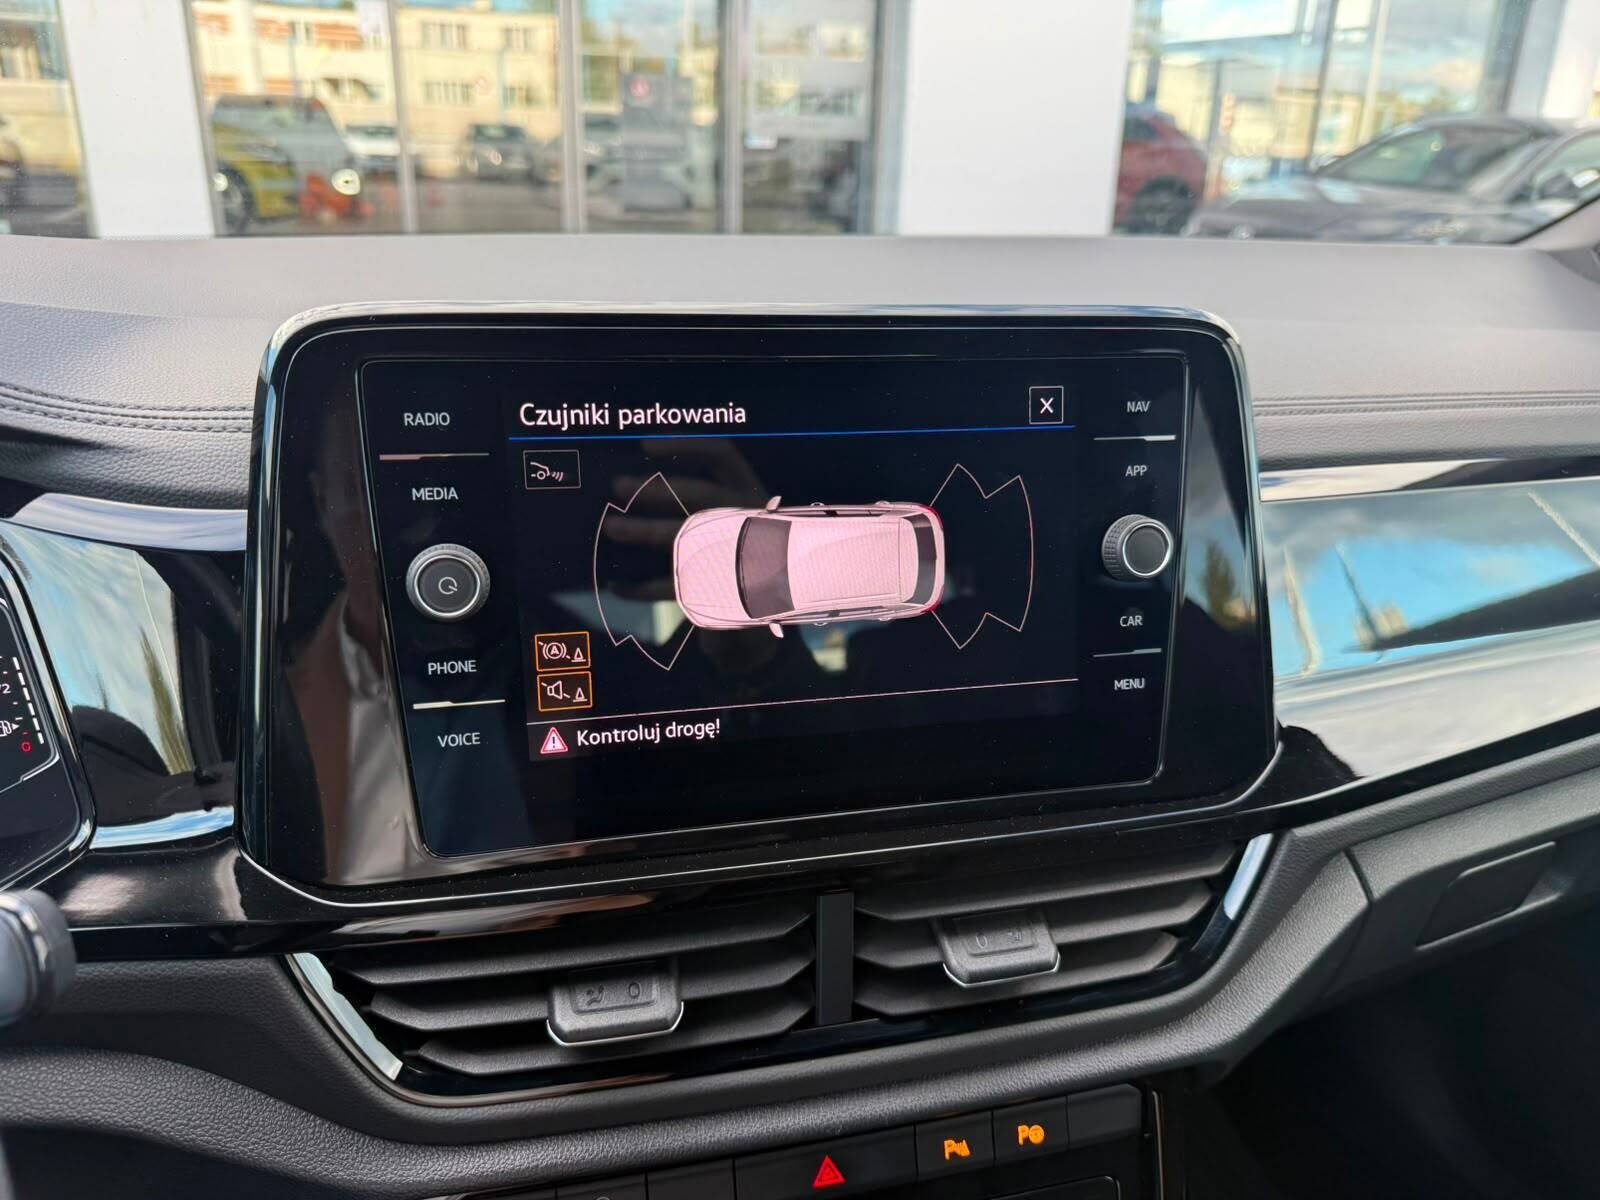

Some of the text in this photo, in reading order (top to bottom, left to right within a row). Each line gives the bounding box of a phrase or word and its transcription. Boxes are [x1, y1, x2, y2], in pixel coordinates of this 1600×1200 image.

[1126, 400, 1151, 413] NAV
[403, 411, 451, 427] RADIO
[519, 401, 746, 432] Czujniki parkowania
[1125, 464, 1148, 477] APP
[411, 486, 459, 501] MEDIA
[1119, 614, 1143, 627] CAR
[427, 660, 477, 676] PHONE
[1114, 677, 1146, 691] MENU
[576, 717, 721, 747] Kontroluj drogę!
[21, 741, 32, 752] 0
[437, 732, 481, 748] VOICE
